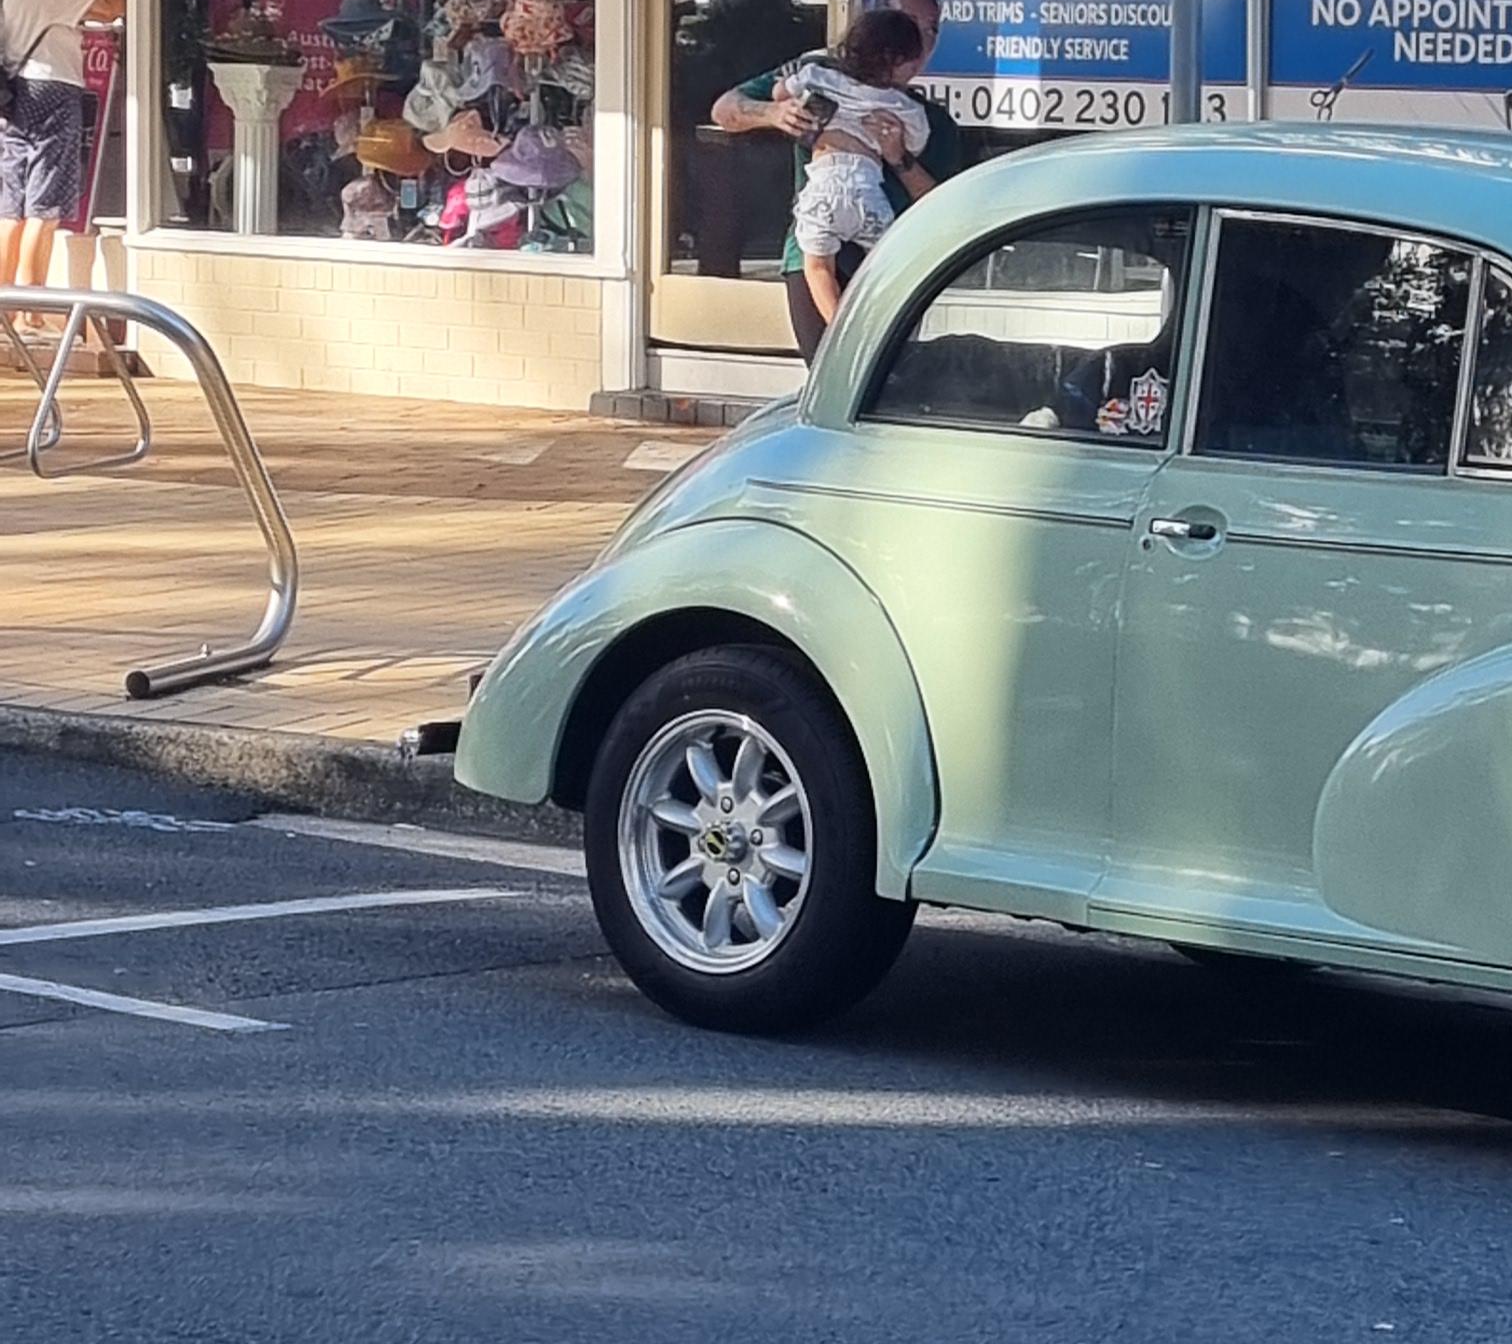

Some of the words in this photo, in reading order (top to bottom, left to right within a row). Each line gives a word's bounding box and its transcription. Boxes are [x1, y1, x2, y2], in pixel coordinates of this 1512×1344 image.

[940, 2, 974, 23] ARD
[976, 2, 1025, 24] TRIMS
[1040, 3, 1107, 26] SENIORS
[986, 36, 1061, 60] FRIENDLY
[1065, 39, 1130, 61] SERVICE
[971, 85, 1064, 124] 0402
[1075, 89, 1146, 125] 230
